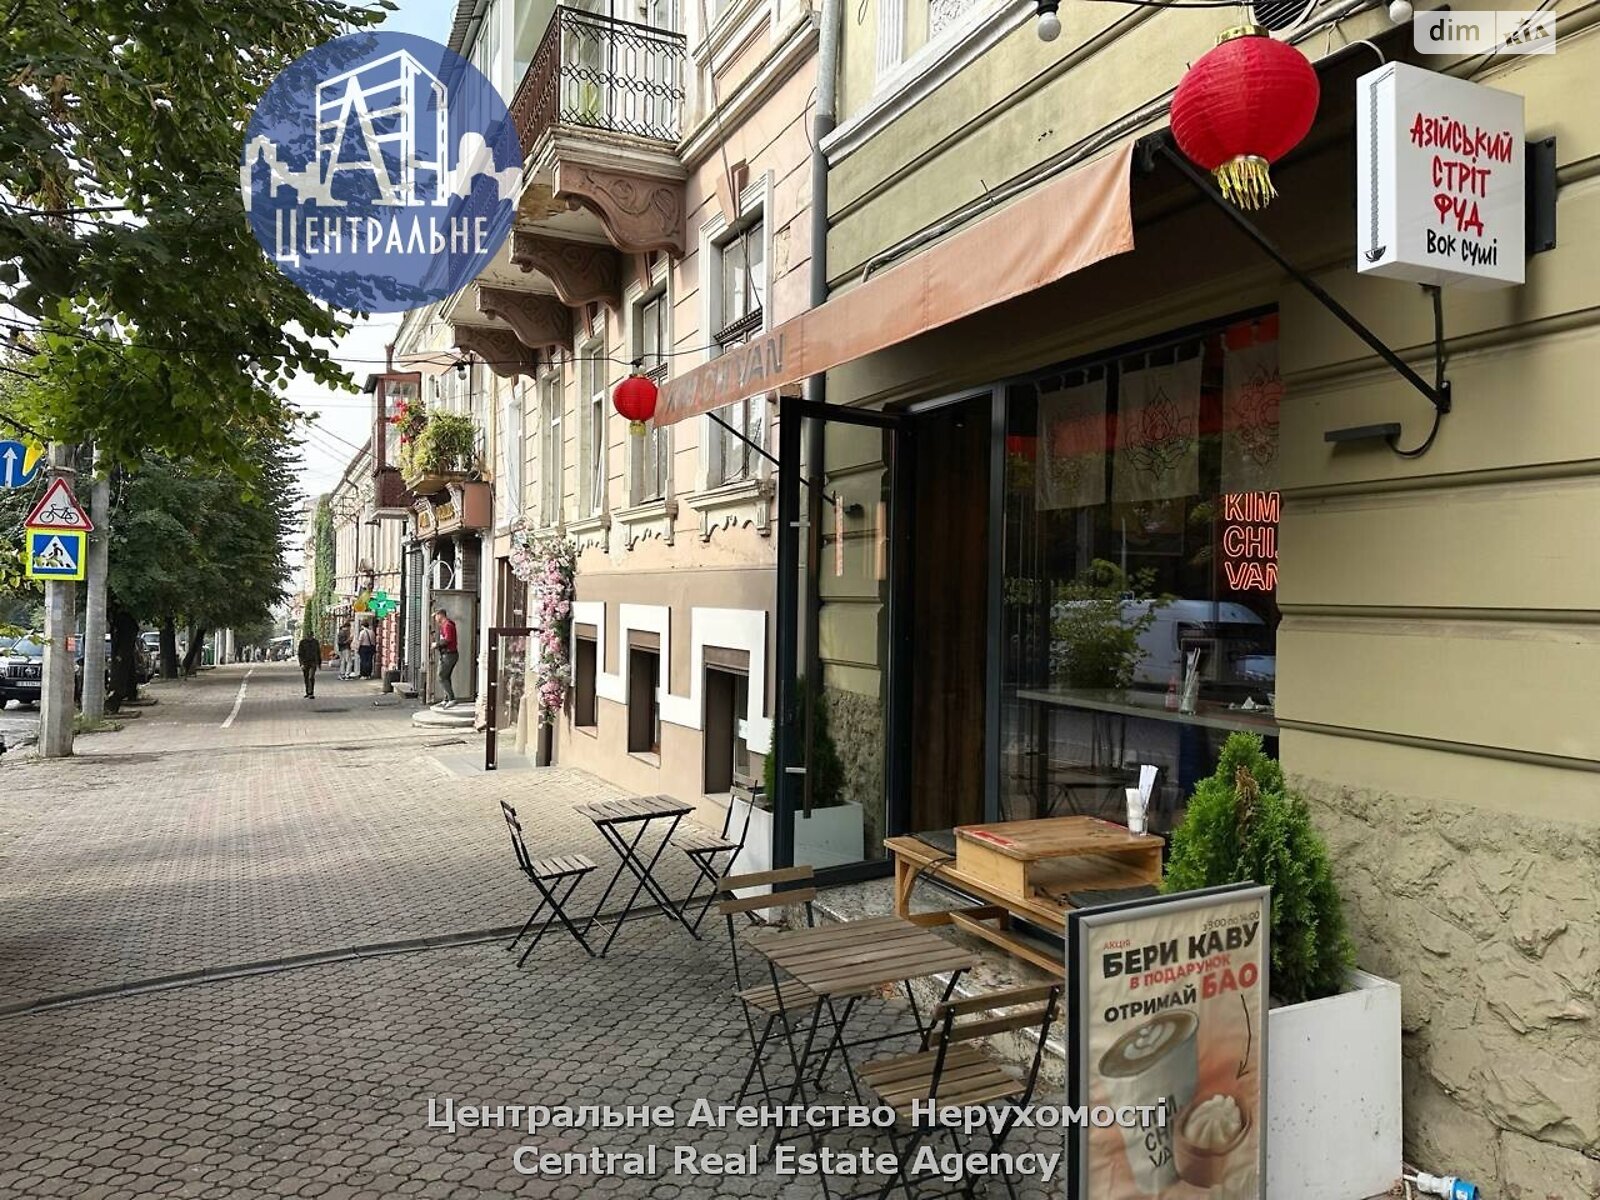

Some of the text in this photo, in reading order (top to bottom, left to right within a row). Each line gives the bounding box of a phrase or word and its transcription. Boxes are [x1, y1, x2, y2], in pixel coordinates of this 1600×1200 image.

[1410, 112, 1513, 164] АЗІЙСЬКИЙ
[1432, 155, 1492, 198] СТРІТ
[1433, 193, 1485, 238] ФУД
[1224, 491, 1280, 524] KIM
[1102, 920, 1260, 979] БЕРИ КАВУ
[1129, 953, 1232, 990] В ПОДАРУНОК
[1104, 962, 1259, 1023] ОТРИМАЙ БАО
